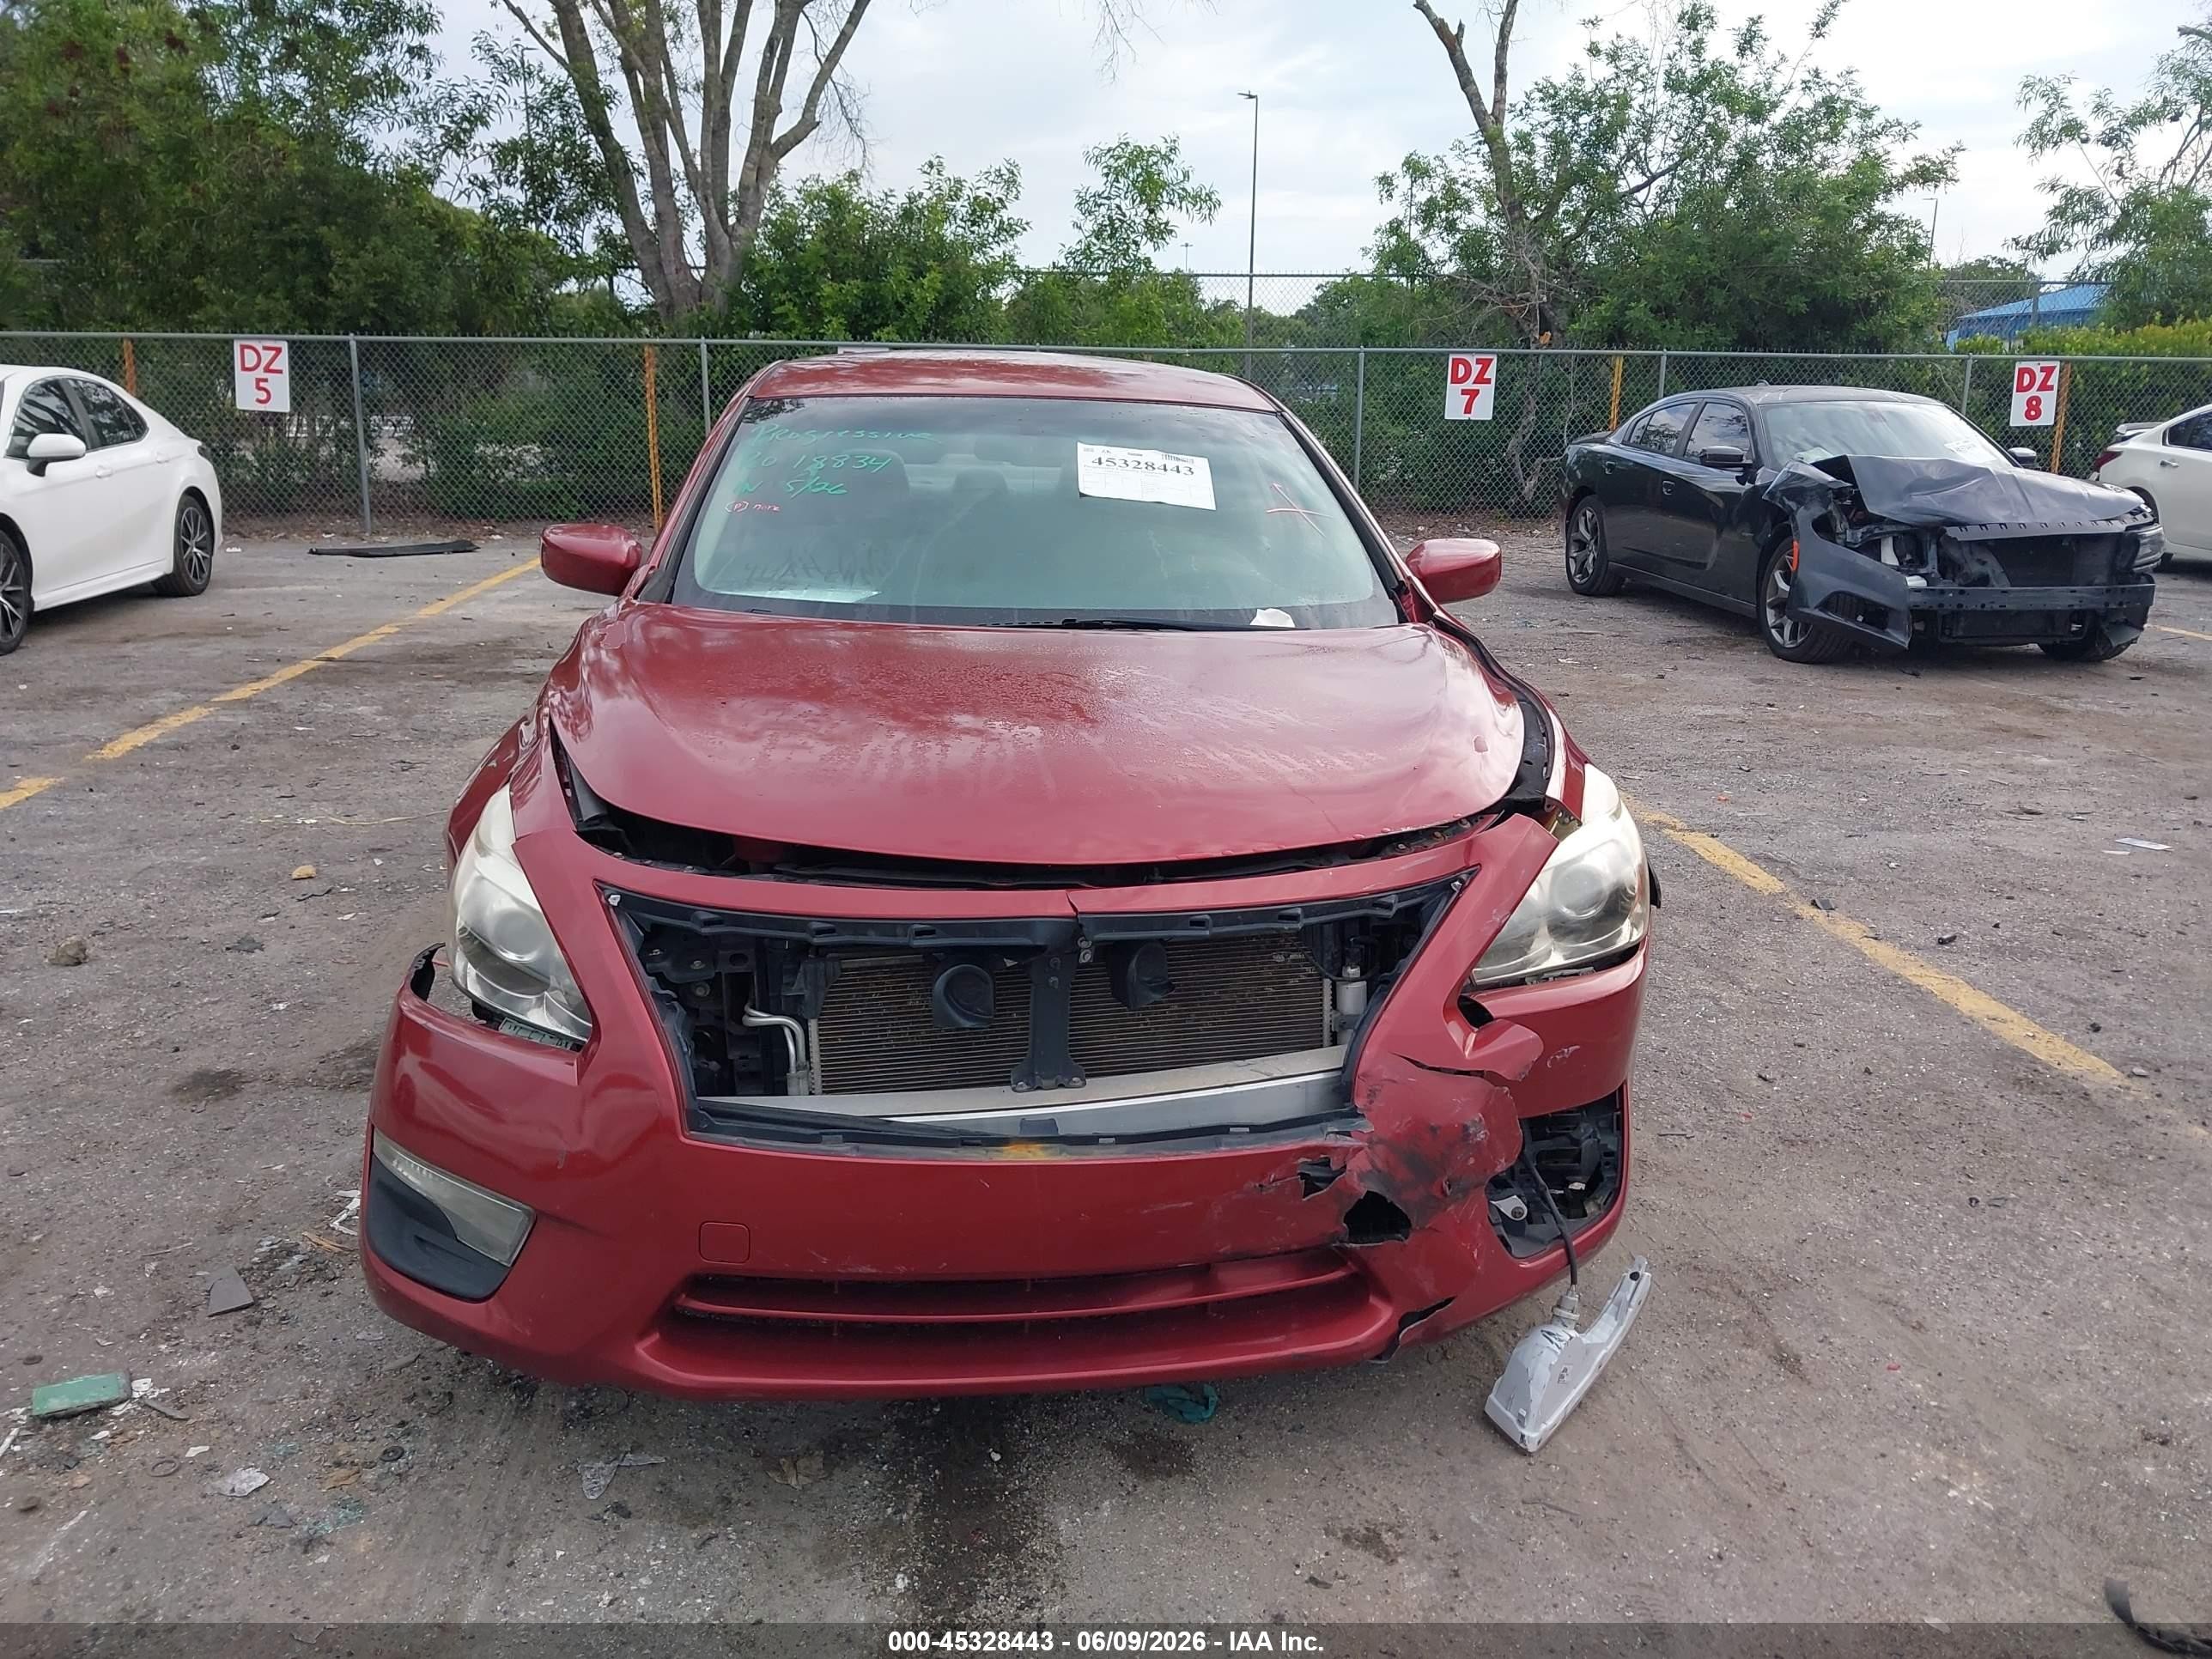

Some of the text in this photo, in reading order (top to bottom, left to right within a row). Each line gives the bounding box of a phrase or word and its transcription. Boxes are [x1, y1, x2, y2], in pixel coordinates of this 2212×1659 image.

[240, 344, 283, 374] DZ
[1450, 357, 1494, 385] DZ
[255, 378, 271, 404] 5
[2015, 366, 2057, 392] DZ
[1461, 389, 1480, 415] 7
[2024, 395, 2043, 421] 8
[1091, 456, 1194, 476] 45328443
